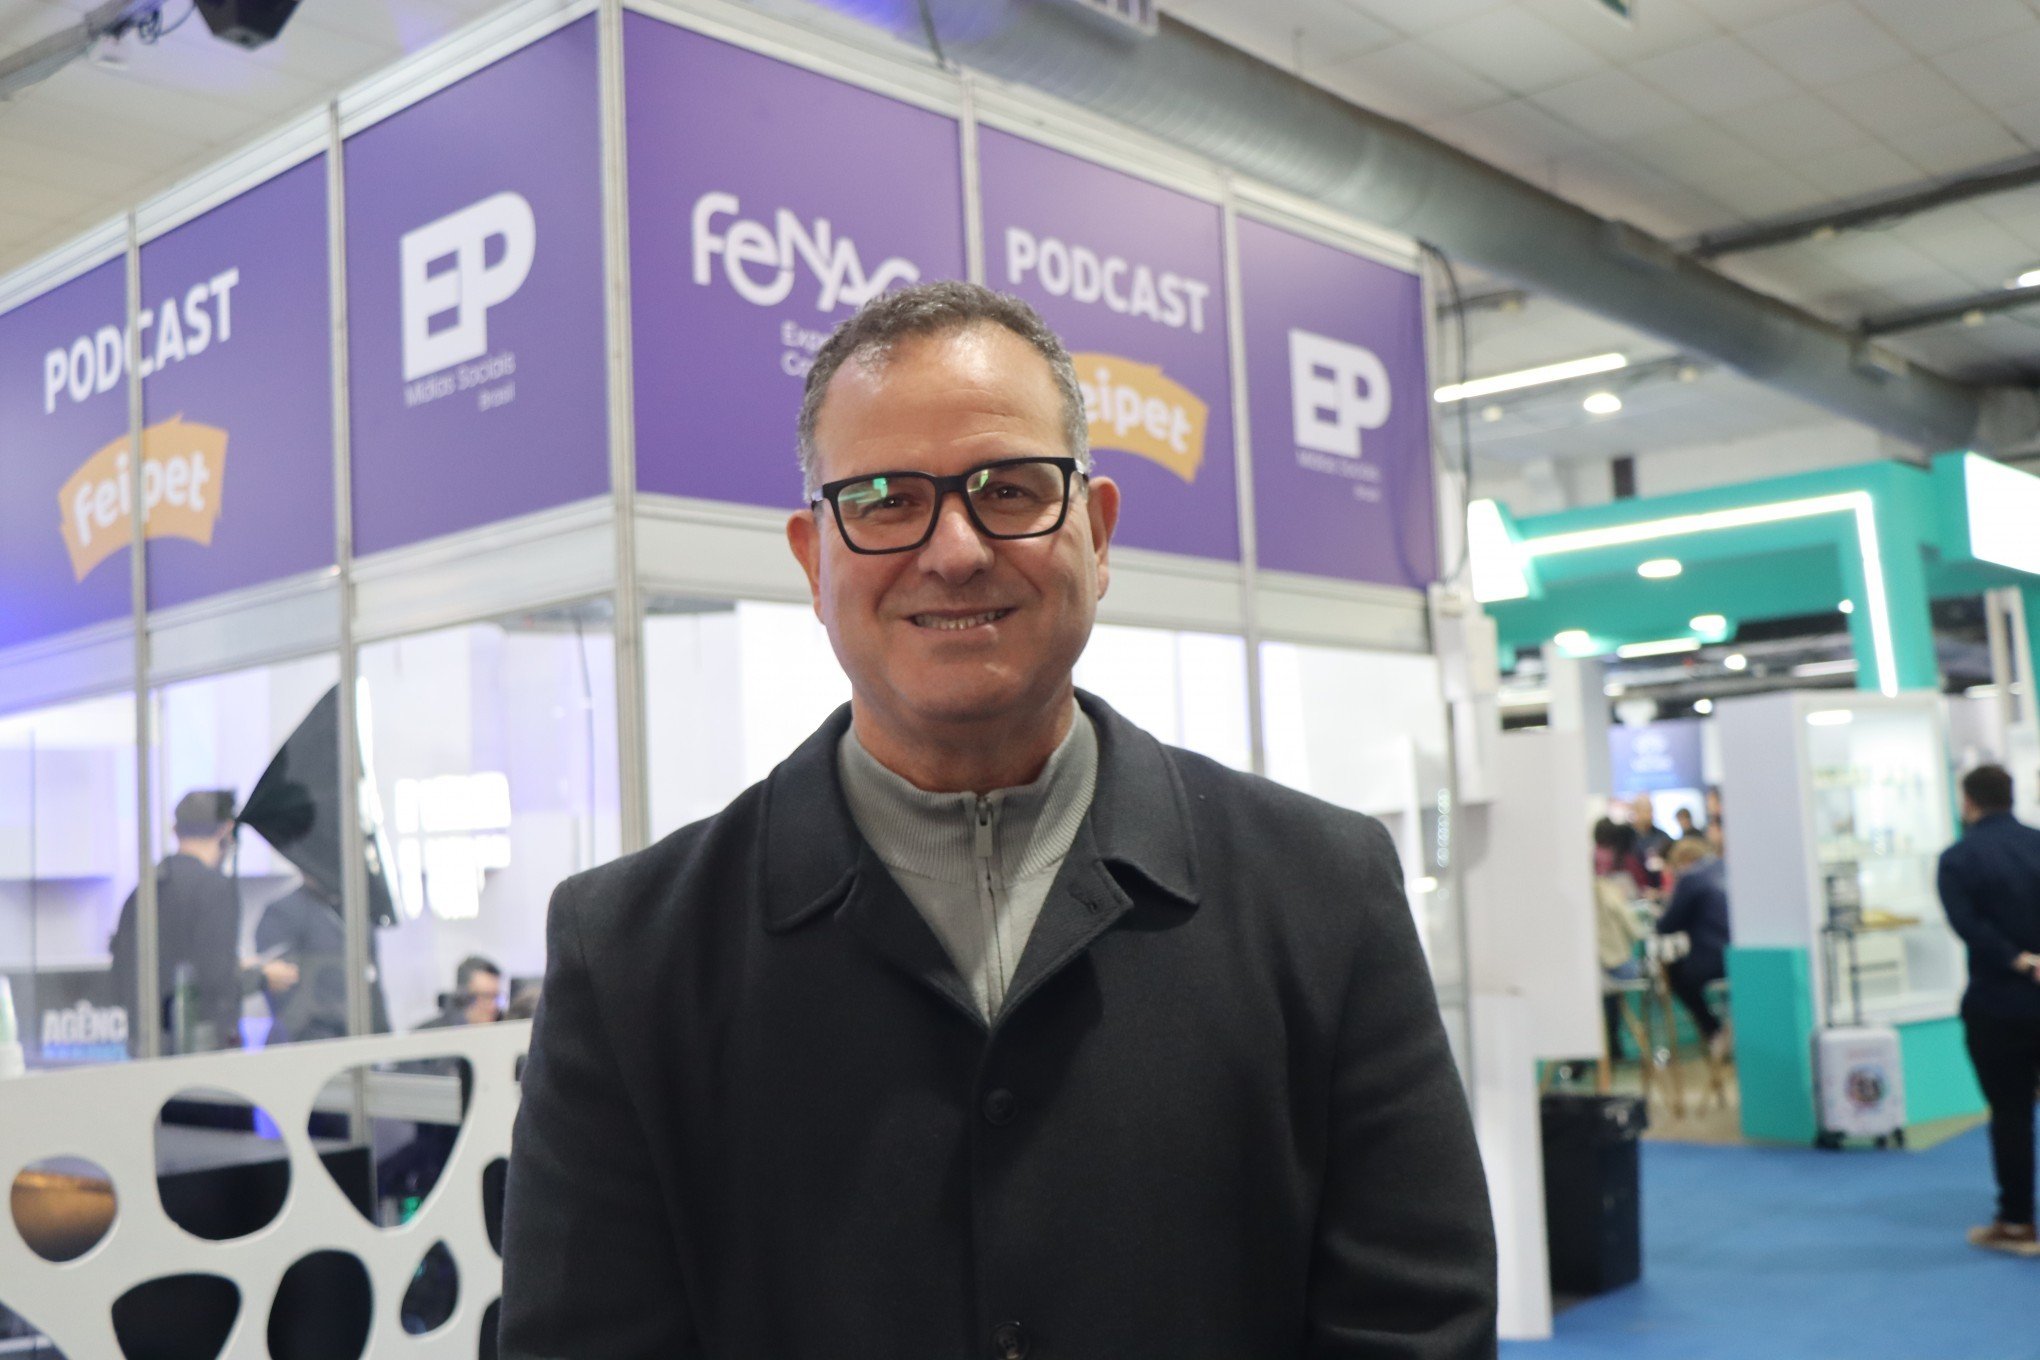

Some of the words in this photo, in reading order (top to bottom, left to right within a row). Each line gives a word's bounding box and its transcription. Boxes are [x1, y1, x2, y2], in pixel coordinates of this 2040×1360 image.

[1006, 227, 1209, 332] PODCAST
[45, 266, 238, 413] PODCAST
[1080, 367, 1192, 455] eipet
[75, 451, 210, 547] feipet
